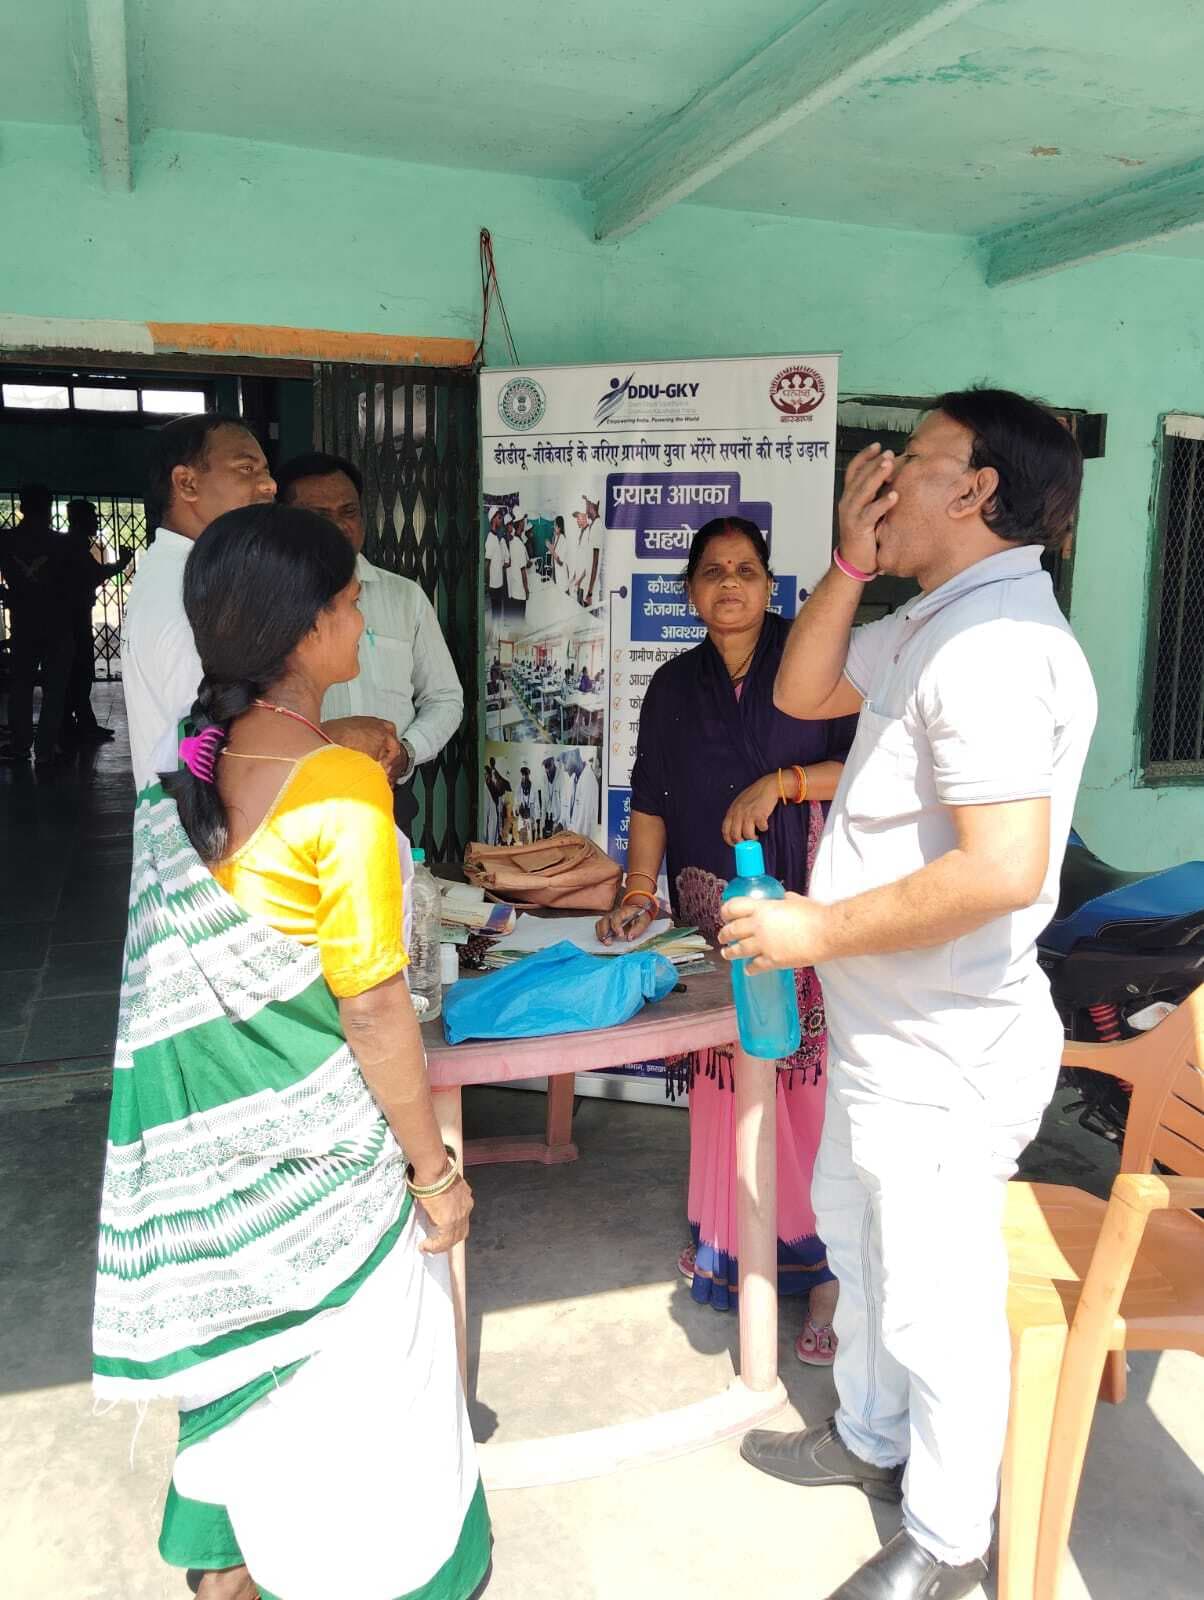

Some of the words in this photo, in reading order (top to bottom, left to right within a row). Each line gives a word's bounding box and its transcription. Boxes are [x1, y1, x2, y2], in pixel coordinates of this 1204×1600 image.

[628, 383, 700, 399] DDU-GKY
[494, 440, 574, 471] डीडीयू-जीकेवाई
[577, 440, 588, 463] के
[591, 439, 620, 466] जरिए
[622, 438, 661, 462] ग्रामीण
[663, 443, 686, 467] युवा
[690, 437, 716, 463] भरेंगे
[720, 436, 752, 462] सपनों
[756, 436, 772, 460] की
[776, 435, 794, 464] नई
[797, 441, 829, 462] उड़ान
[612, 485, 663, 507] प्रयास
[667, 485, 731, 505] आपका
[644, 524, 699, 550] सहयो
[643, 598, 687, 617] रोजगार
[629, 647, 654, 662] ग्रामीण
